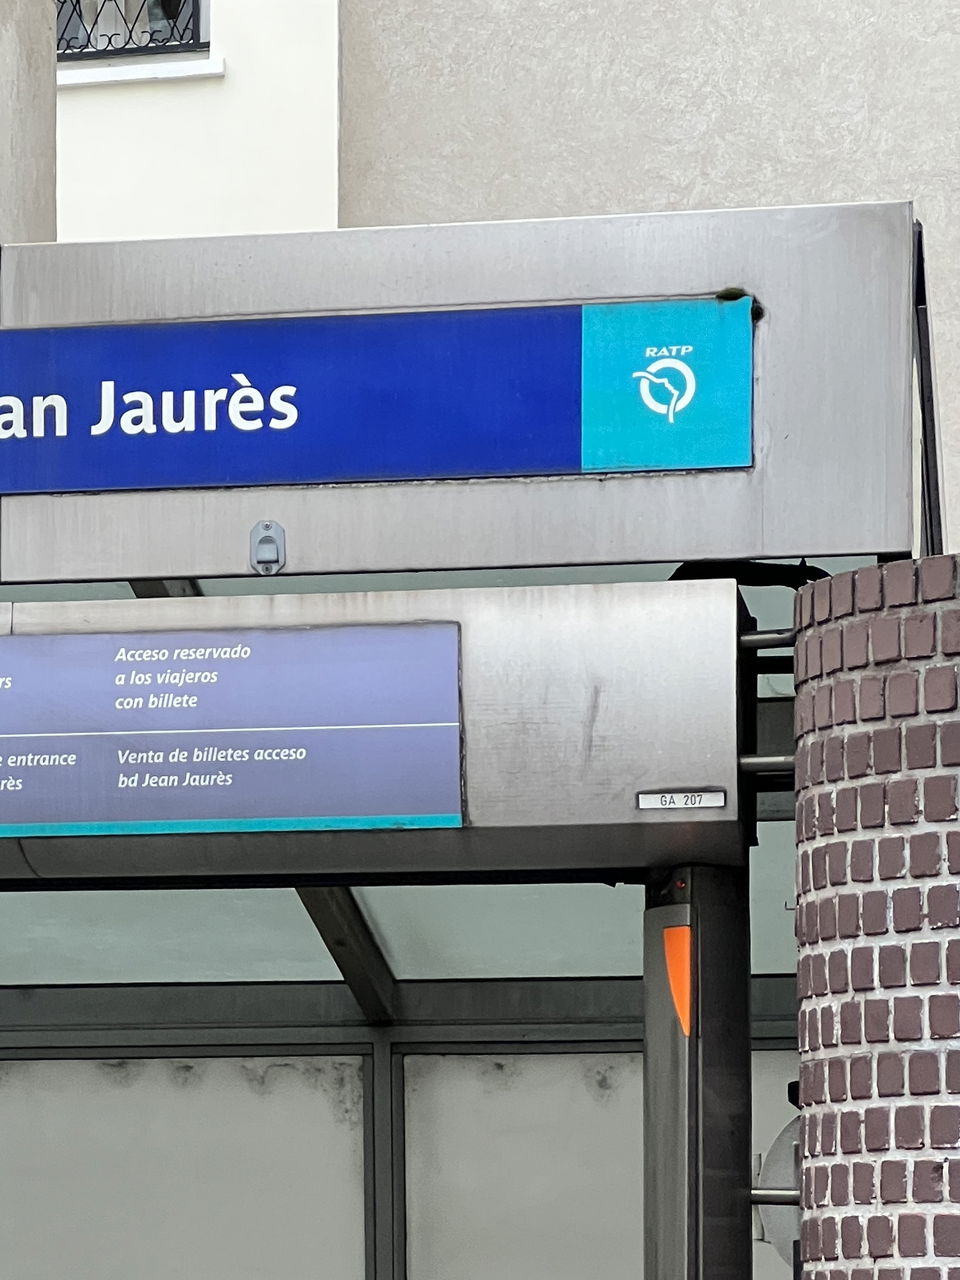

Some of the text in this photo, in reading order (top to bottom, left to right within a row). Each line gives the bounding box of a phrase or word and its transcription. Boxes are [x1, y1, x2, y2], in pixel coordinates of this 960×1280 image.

[645, 345, 693, 356] RATP
[91, 373, 298, 435] Jaurès
[114, 643, 252, 663] Acceso reservado
[114, 667, 219, 687] a los viajeros
[114, 692, 198, 710] con billete
[7, 751, 77, 768] entrance
[117, 745, 307, 765] Venta de billetes acceso
[118, 770, 233, 789] bd Jean Jaurès
[660, 794, 703, 806] GA 207
